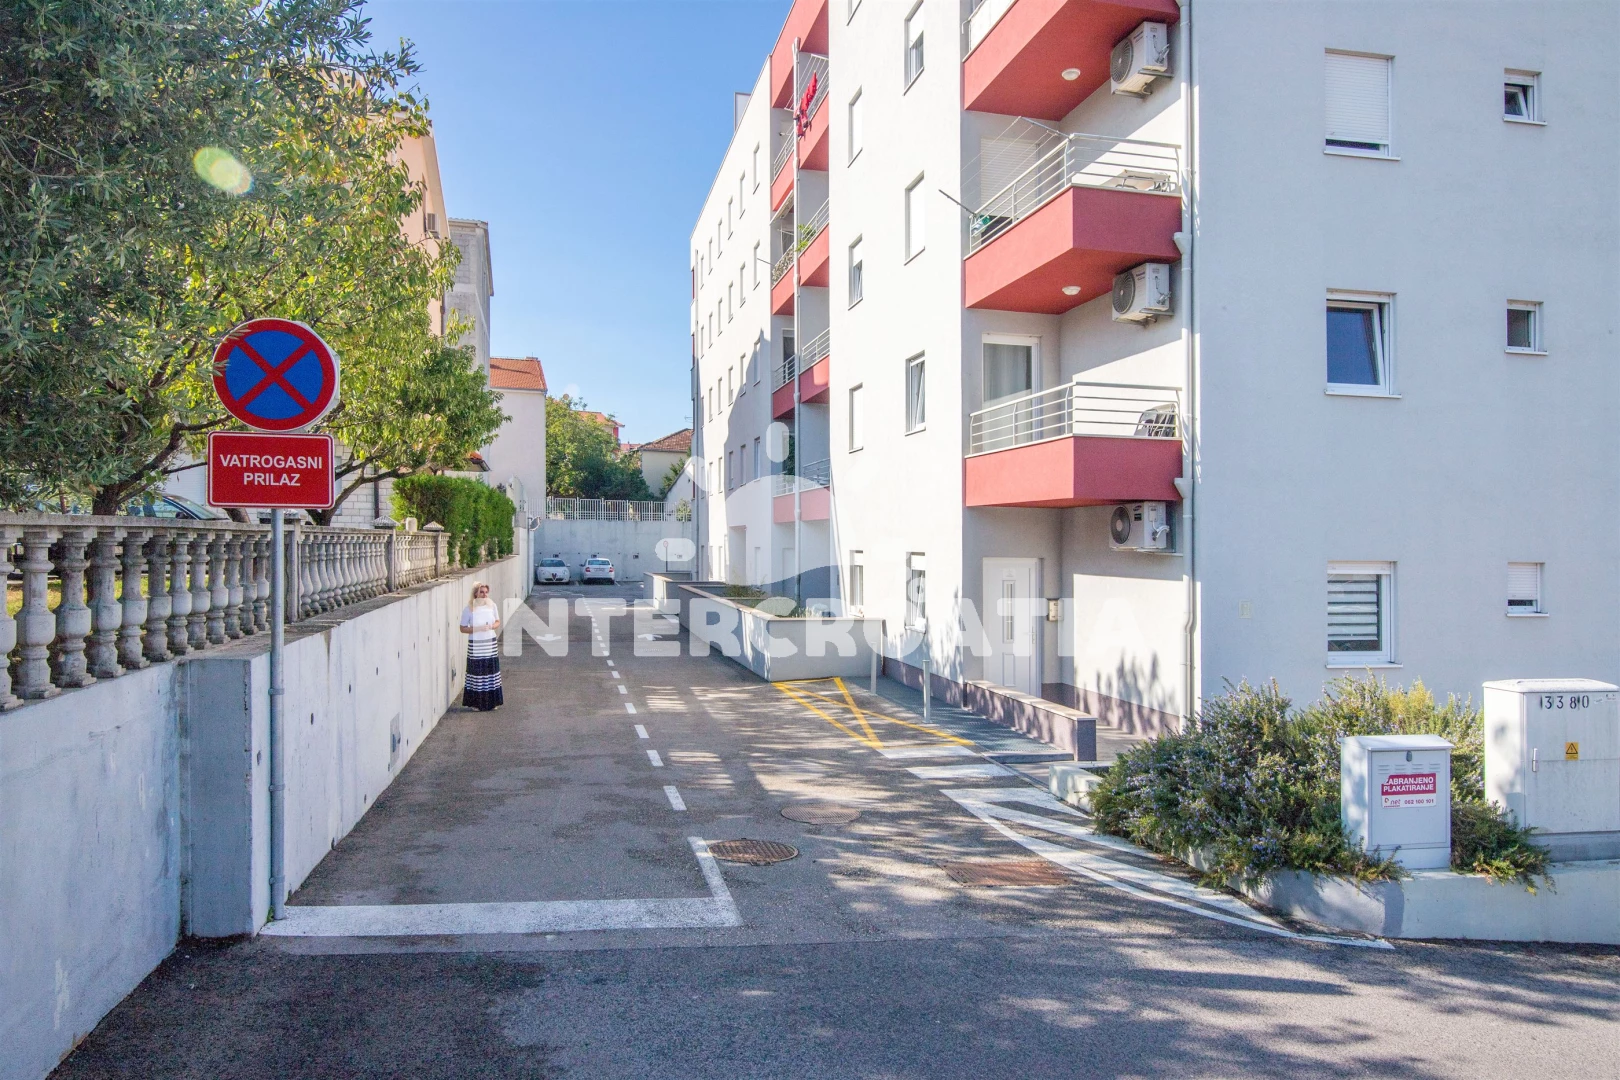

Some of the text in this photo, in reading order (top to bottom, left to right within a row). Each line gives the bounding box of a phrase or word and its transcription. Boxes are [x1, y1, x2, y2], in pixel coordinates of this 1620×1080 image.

[219, 454, 323, 469] VATROGASNI
[243, 472, 301, 487] PRILAZ
[1383, 784, 1434, 792] PLAKATIRANJE
